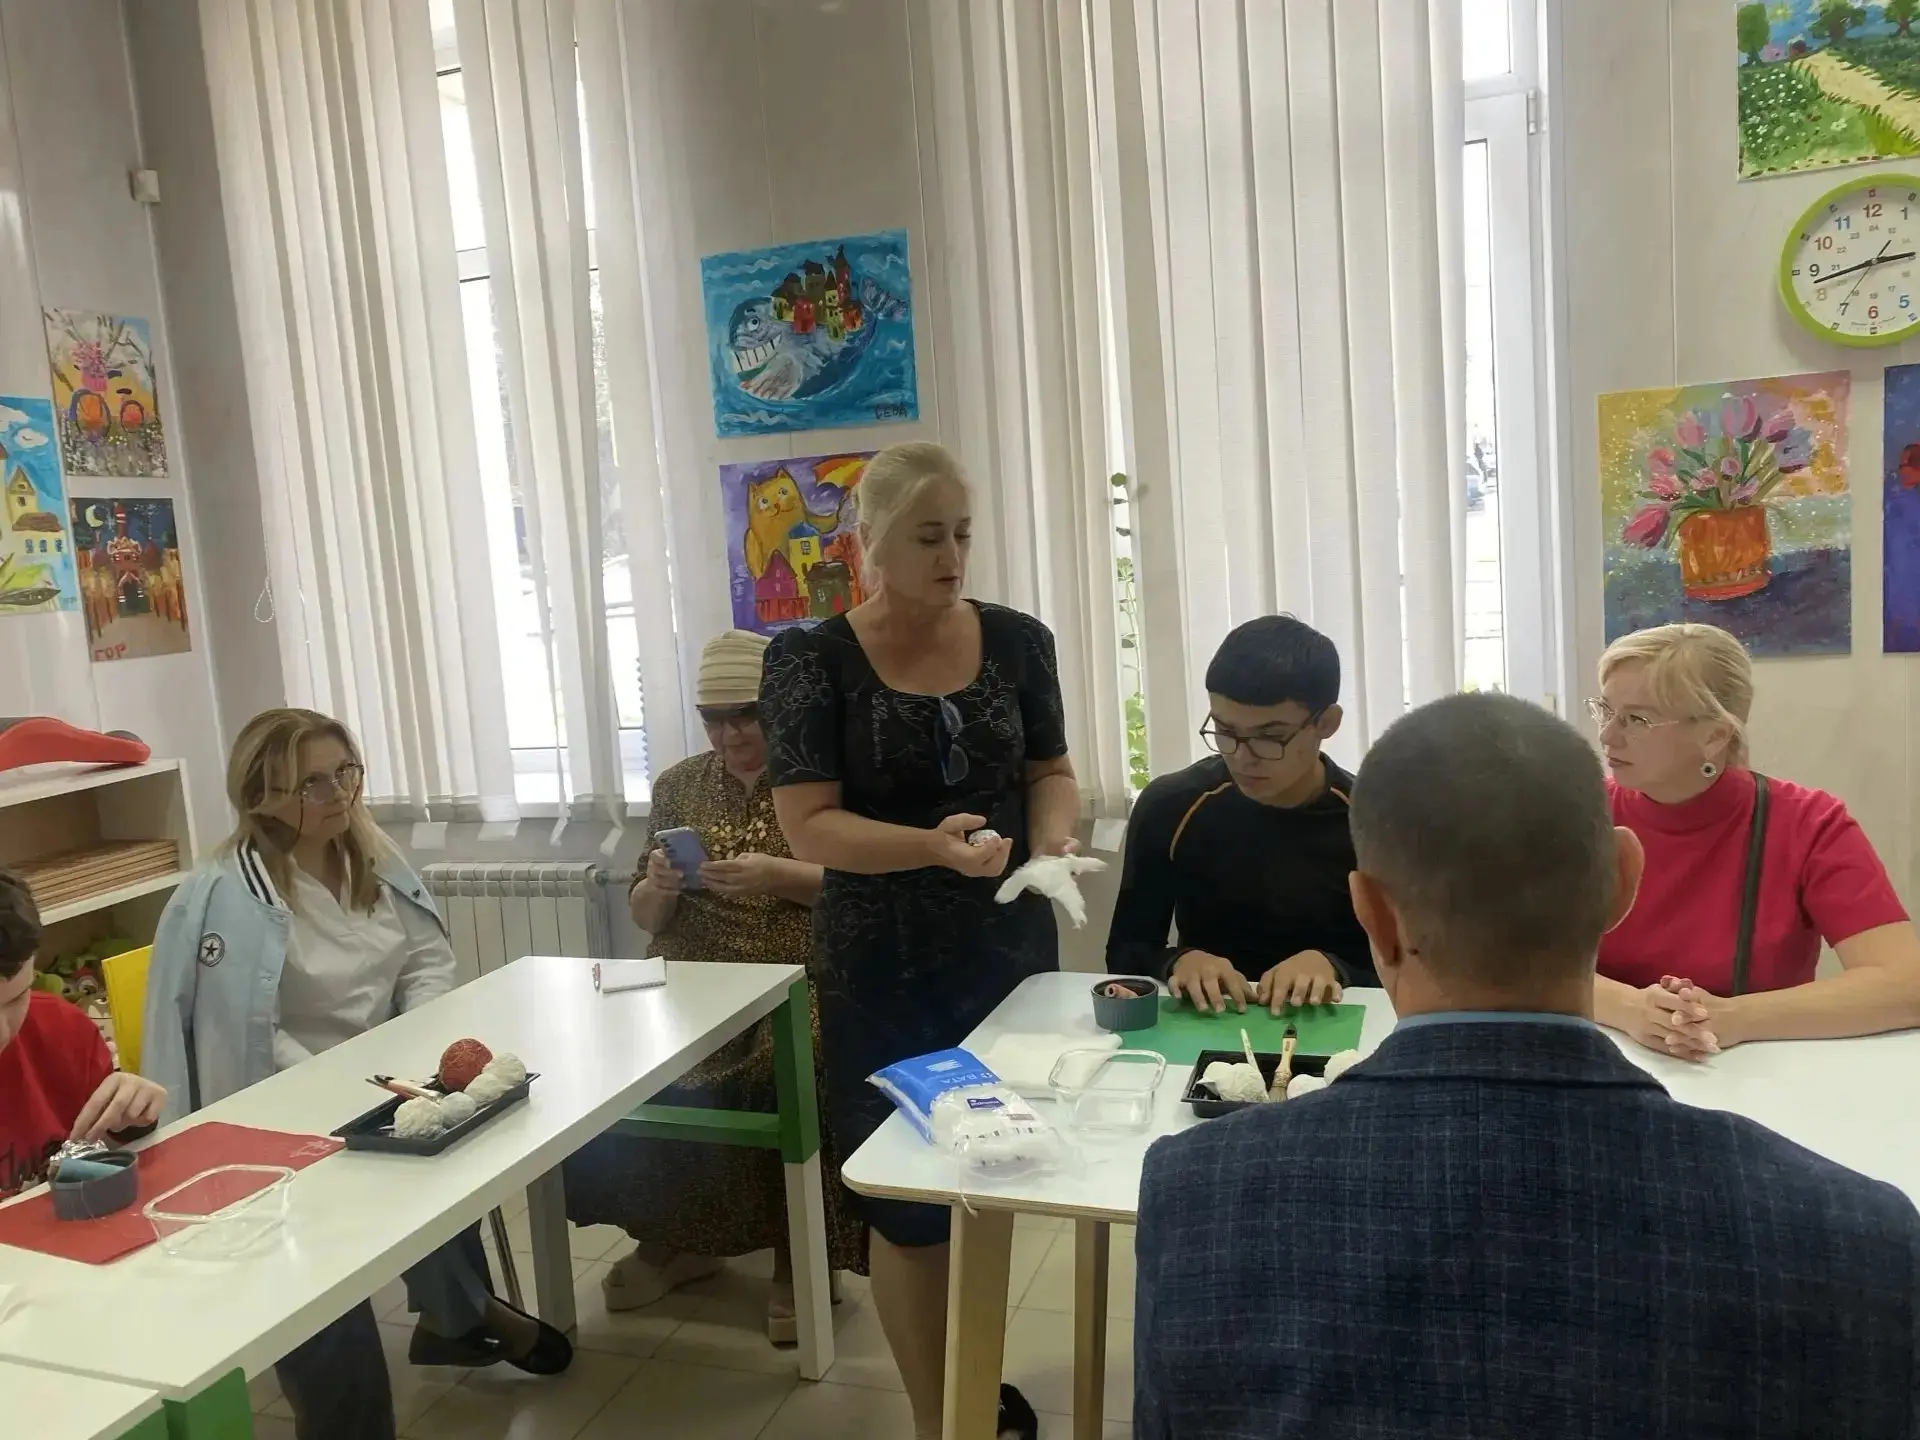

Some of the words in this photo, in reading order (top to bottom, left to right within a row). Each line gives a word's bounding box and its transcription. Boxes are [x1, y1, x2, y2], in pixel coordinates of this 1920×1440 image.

[1862, 203, 1882, 218] 12
[1900, 206, 1908, 220] 1
[1834, 216, 1851, 230] 11
[1814, 236, 1833, 251] 10
[1809, 263, 1820, 277] 9
[1816, 287, 1828, 301] 8
[1899, 295, 1910, 308] 5
[1839, 302, 1849, 316] 7
[1868, 306, 1879, 319] 6
